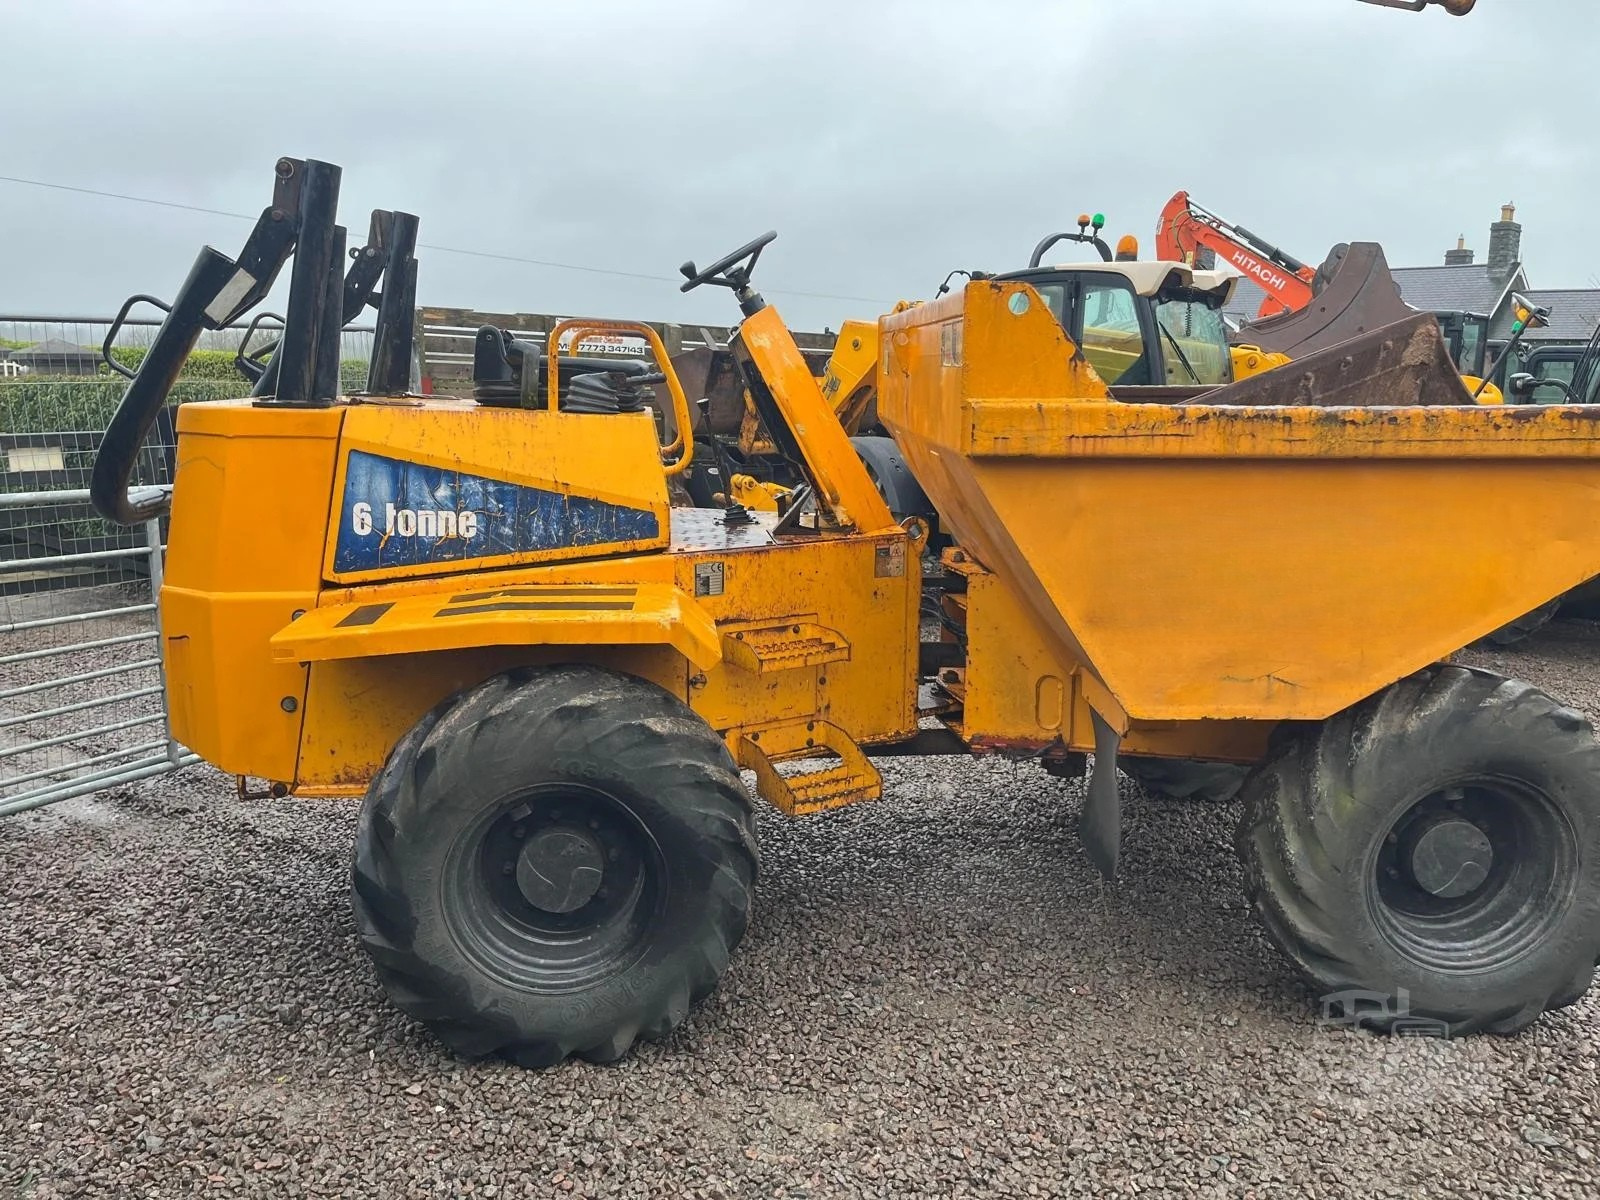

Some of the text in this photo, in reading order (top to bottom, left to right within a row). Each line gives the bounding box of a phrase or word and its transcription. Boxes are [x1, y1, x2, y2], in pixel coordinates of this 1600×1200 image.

[1232, 250, 1286, 290] HITACHI
[576, 344, 606, 352] 7773
[608, 345, 644, 354] 347143
[352, 502, 477, 538] 6 tonne
